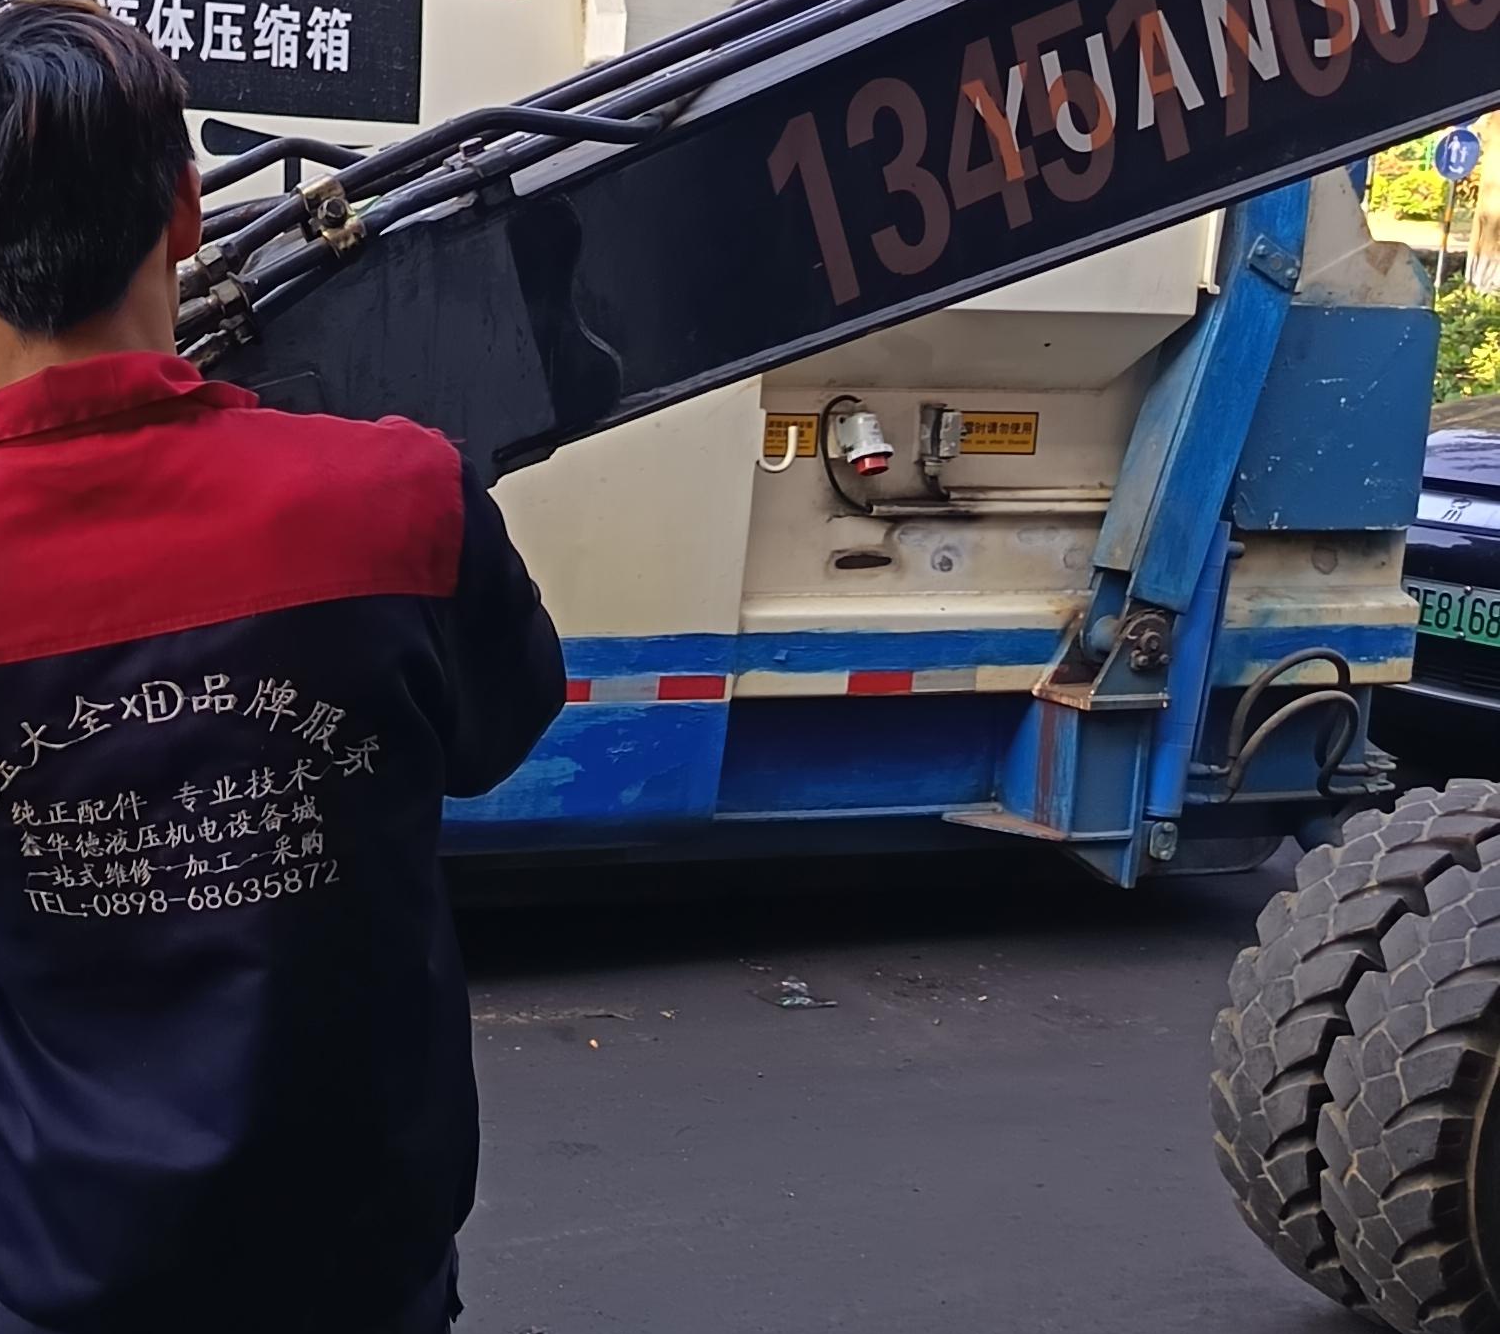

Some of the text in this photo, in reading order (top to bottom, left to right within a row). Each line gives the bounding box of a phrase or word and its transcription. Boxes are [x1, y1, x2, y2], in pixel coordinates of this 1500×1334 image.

[11, 759, 322, 826] 纯正配件 专业技术
